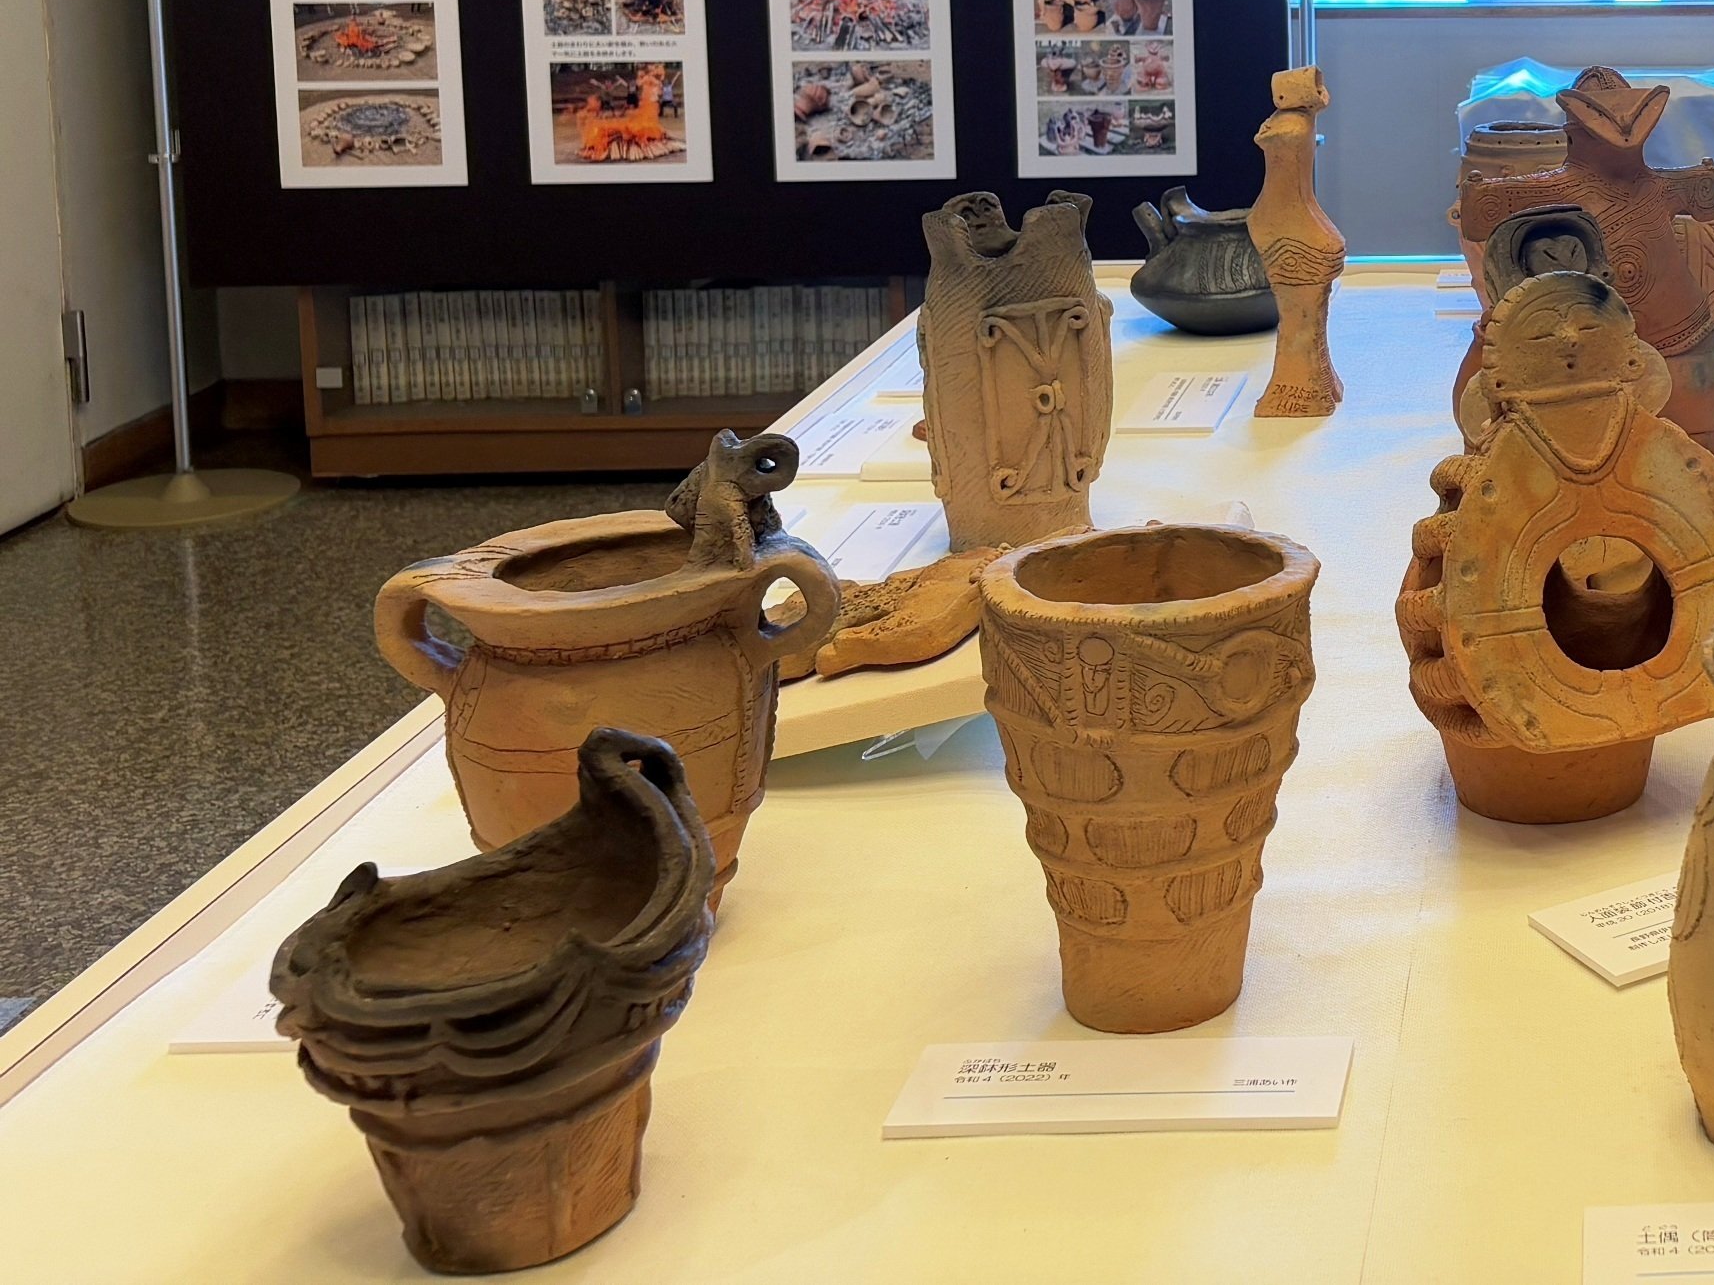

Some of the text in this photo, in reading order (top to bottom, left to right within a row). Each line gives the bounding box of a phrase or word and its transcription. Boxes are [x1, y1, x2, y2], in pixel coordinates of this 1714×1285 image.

[957, 1062, 1057, 1074] 深鉢形土器
